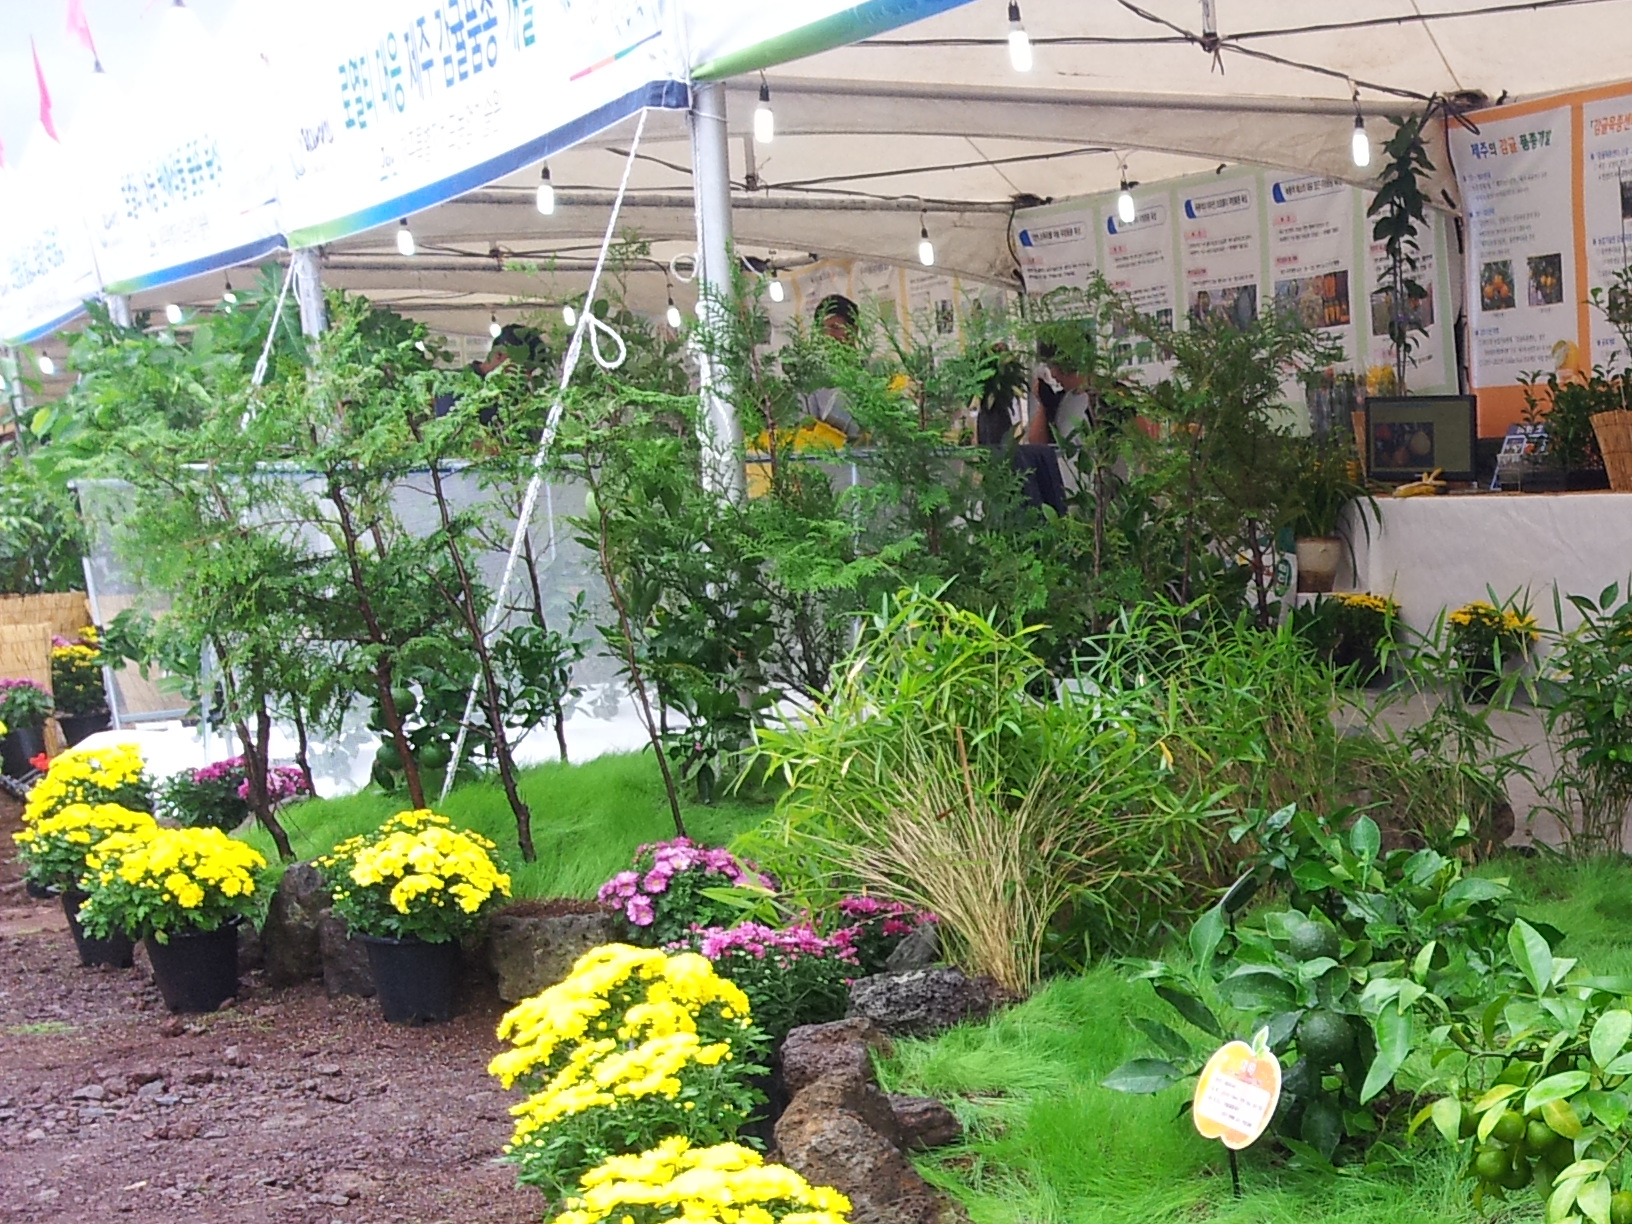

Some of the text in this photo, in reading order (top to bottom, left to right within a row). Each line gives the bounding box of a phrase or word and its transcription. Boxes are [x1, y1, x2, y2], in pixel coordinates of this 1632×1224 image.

[337, 50, 379, 130] 로열티
[375, 31, 407, 114] 대응
[403, 15, 436, 100] 제주
[1470, 129, 1553, 160] 제주의 감귤 품종개발
